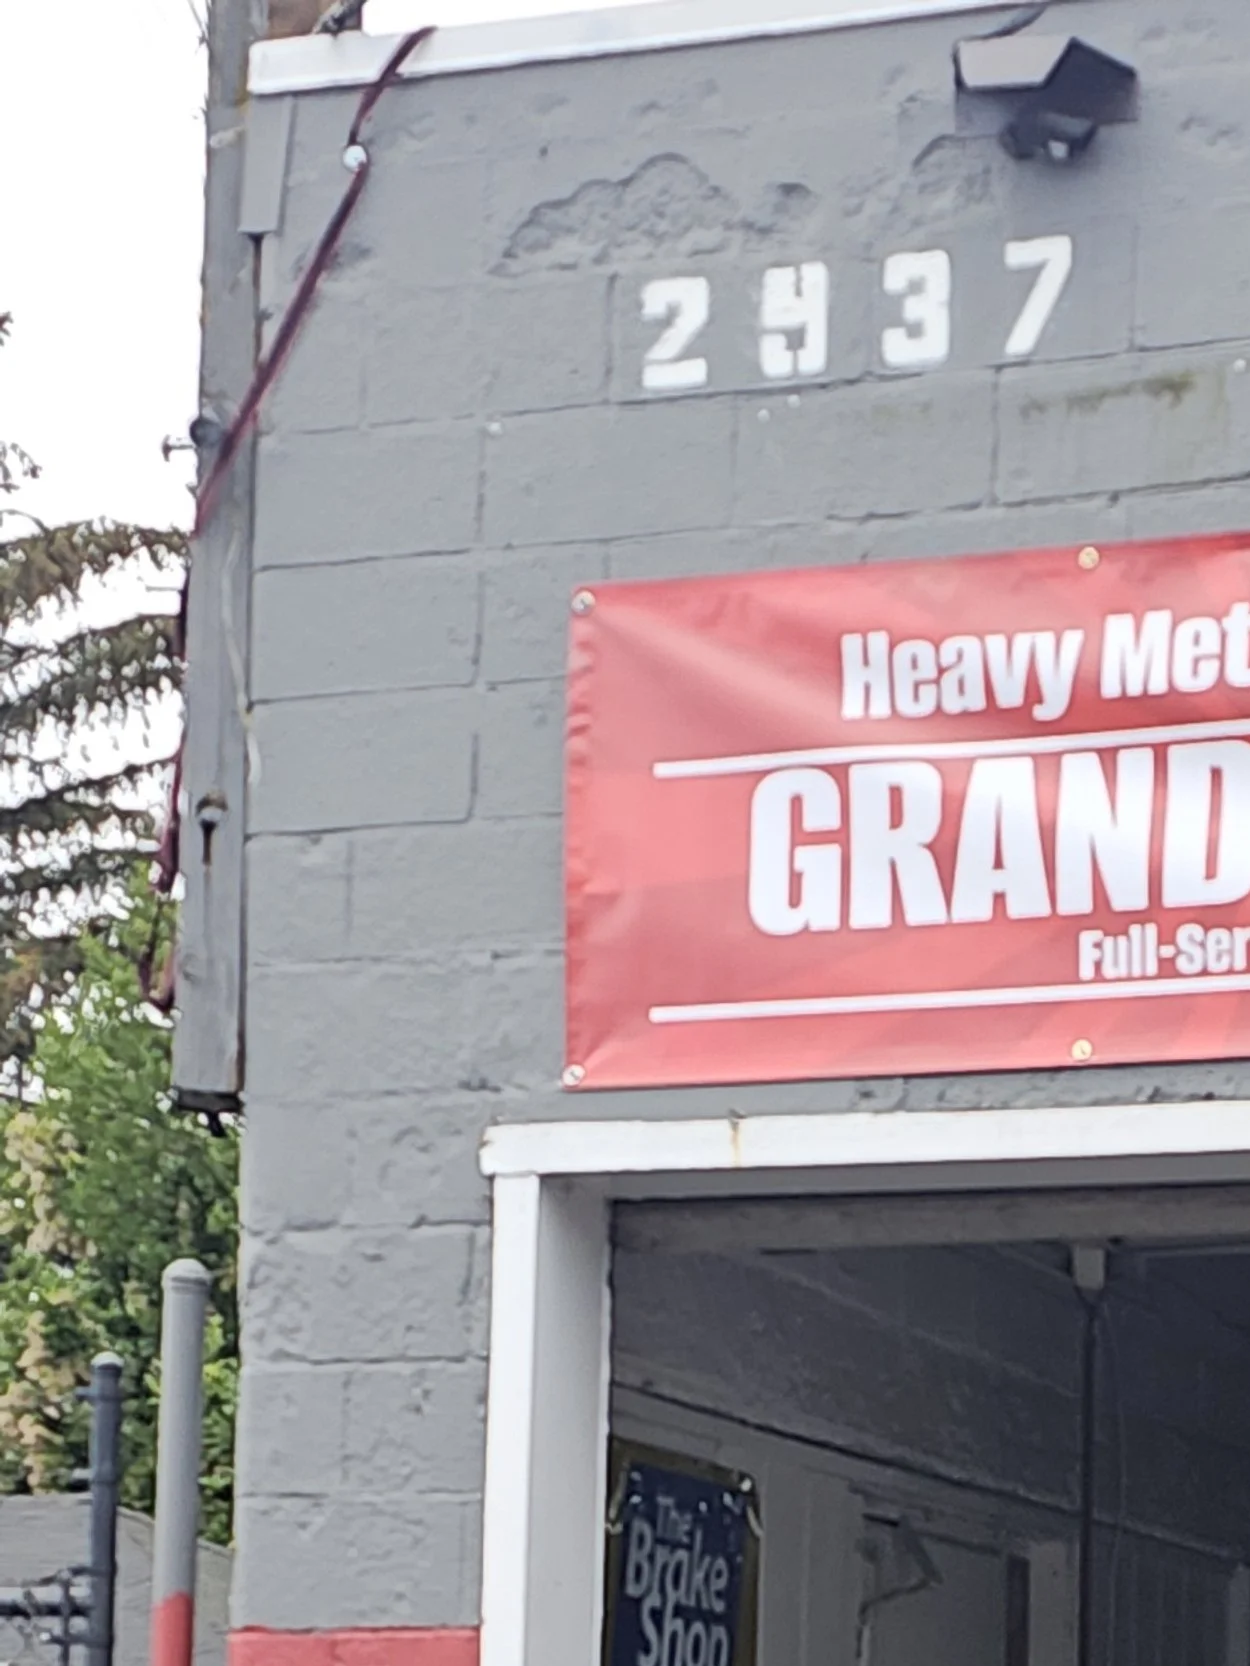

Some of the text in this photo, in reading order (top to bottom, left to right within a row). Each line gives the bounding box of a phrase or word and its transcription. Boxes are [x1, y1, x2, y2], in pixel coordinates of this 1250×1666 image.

[641, 235, 1073, 389] 2937
[840, 629, 1085, 722] Heavy
[625, 1517, 729, 1613] Brake
[656, 1495, 693, 1544] The
